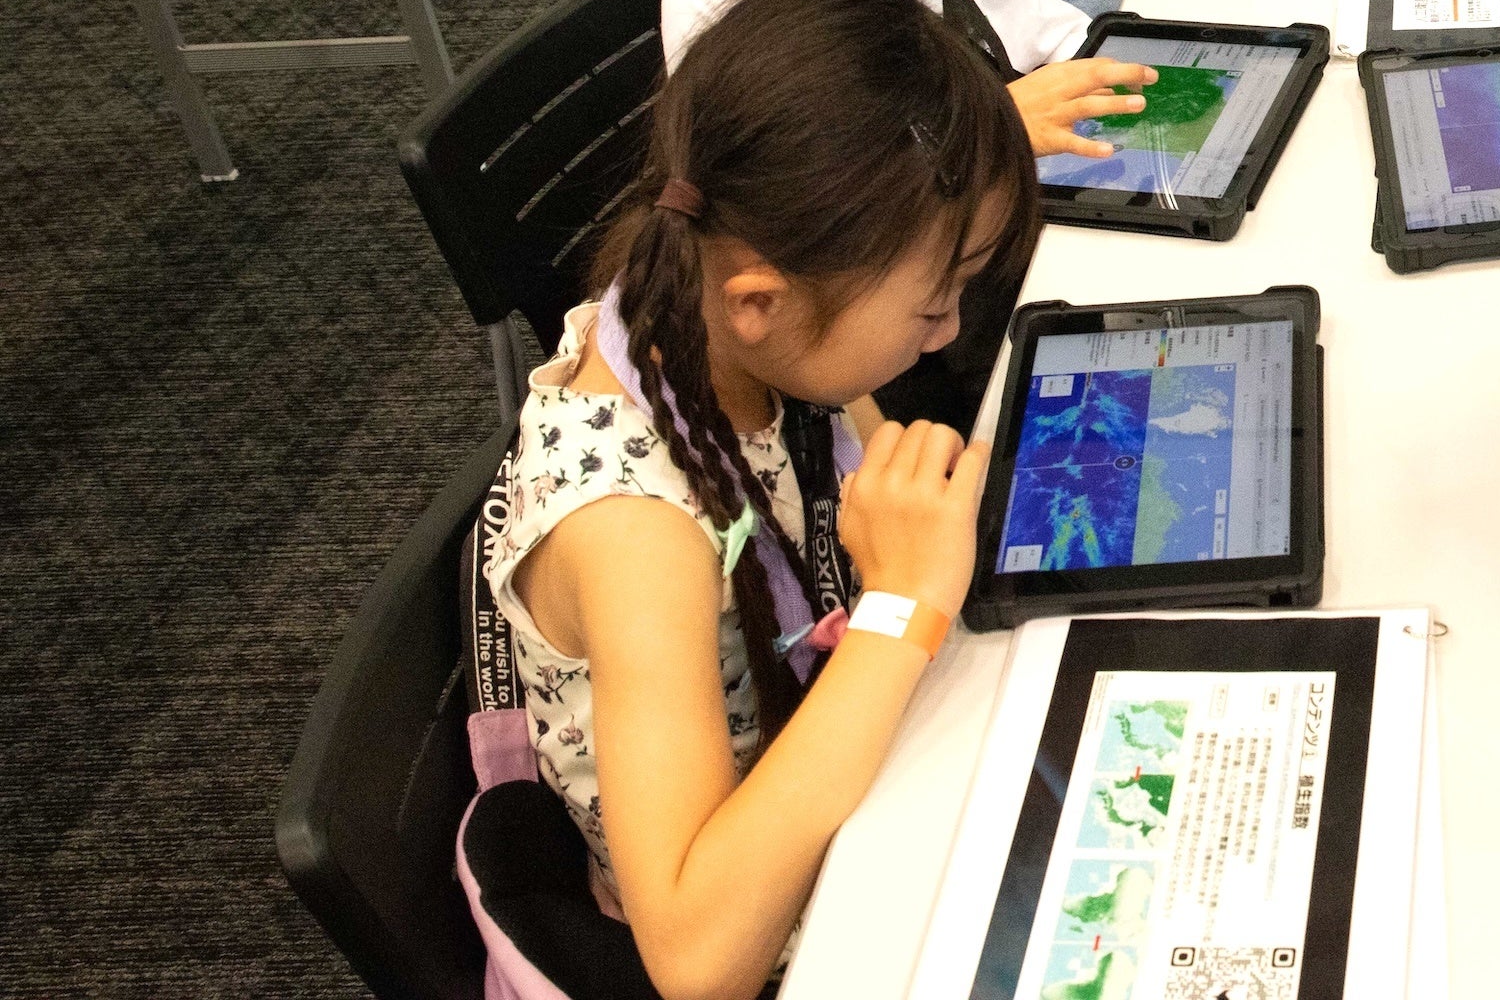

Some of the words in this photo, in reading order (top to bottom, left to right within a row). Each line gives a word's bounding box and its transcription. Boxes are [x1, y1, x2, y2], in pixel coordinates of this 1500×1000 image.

[478, 610, 494, 627] in
[493, 599, 508, 633] ou
[479, 632, 494, 662] the
[495, 637, 511, 681] wish
[497, 686, 512, 703] to
